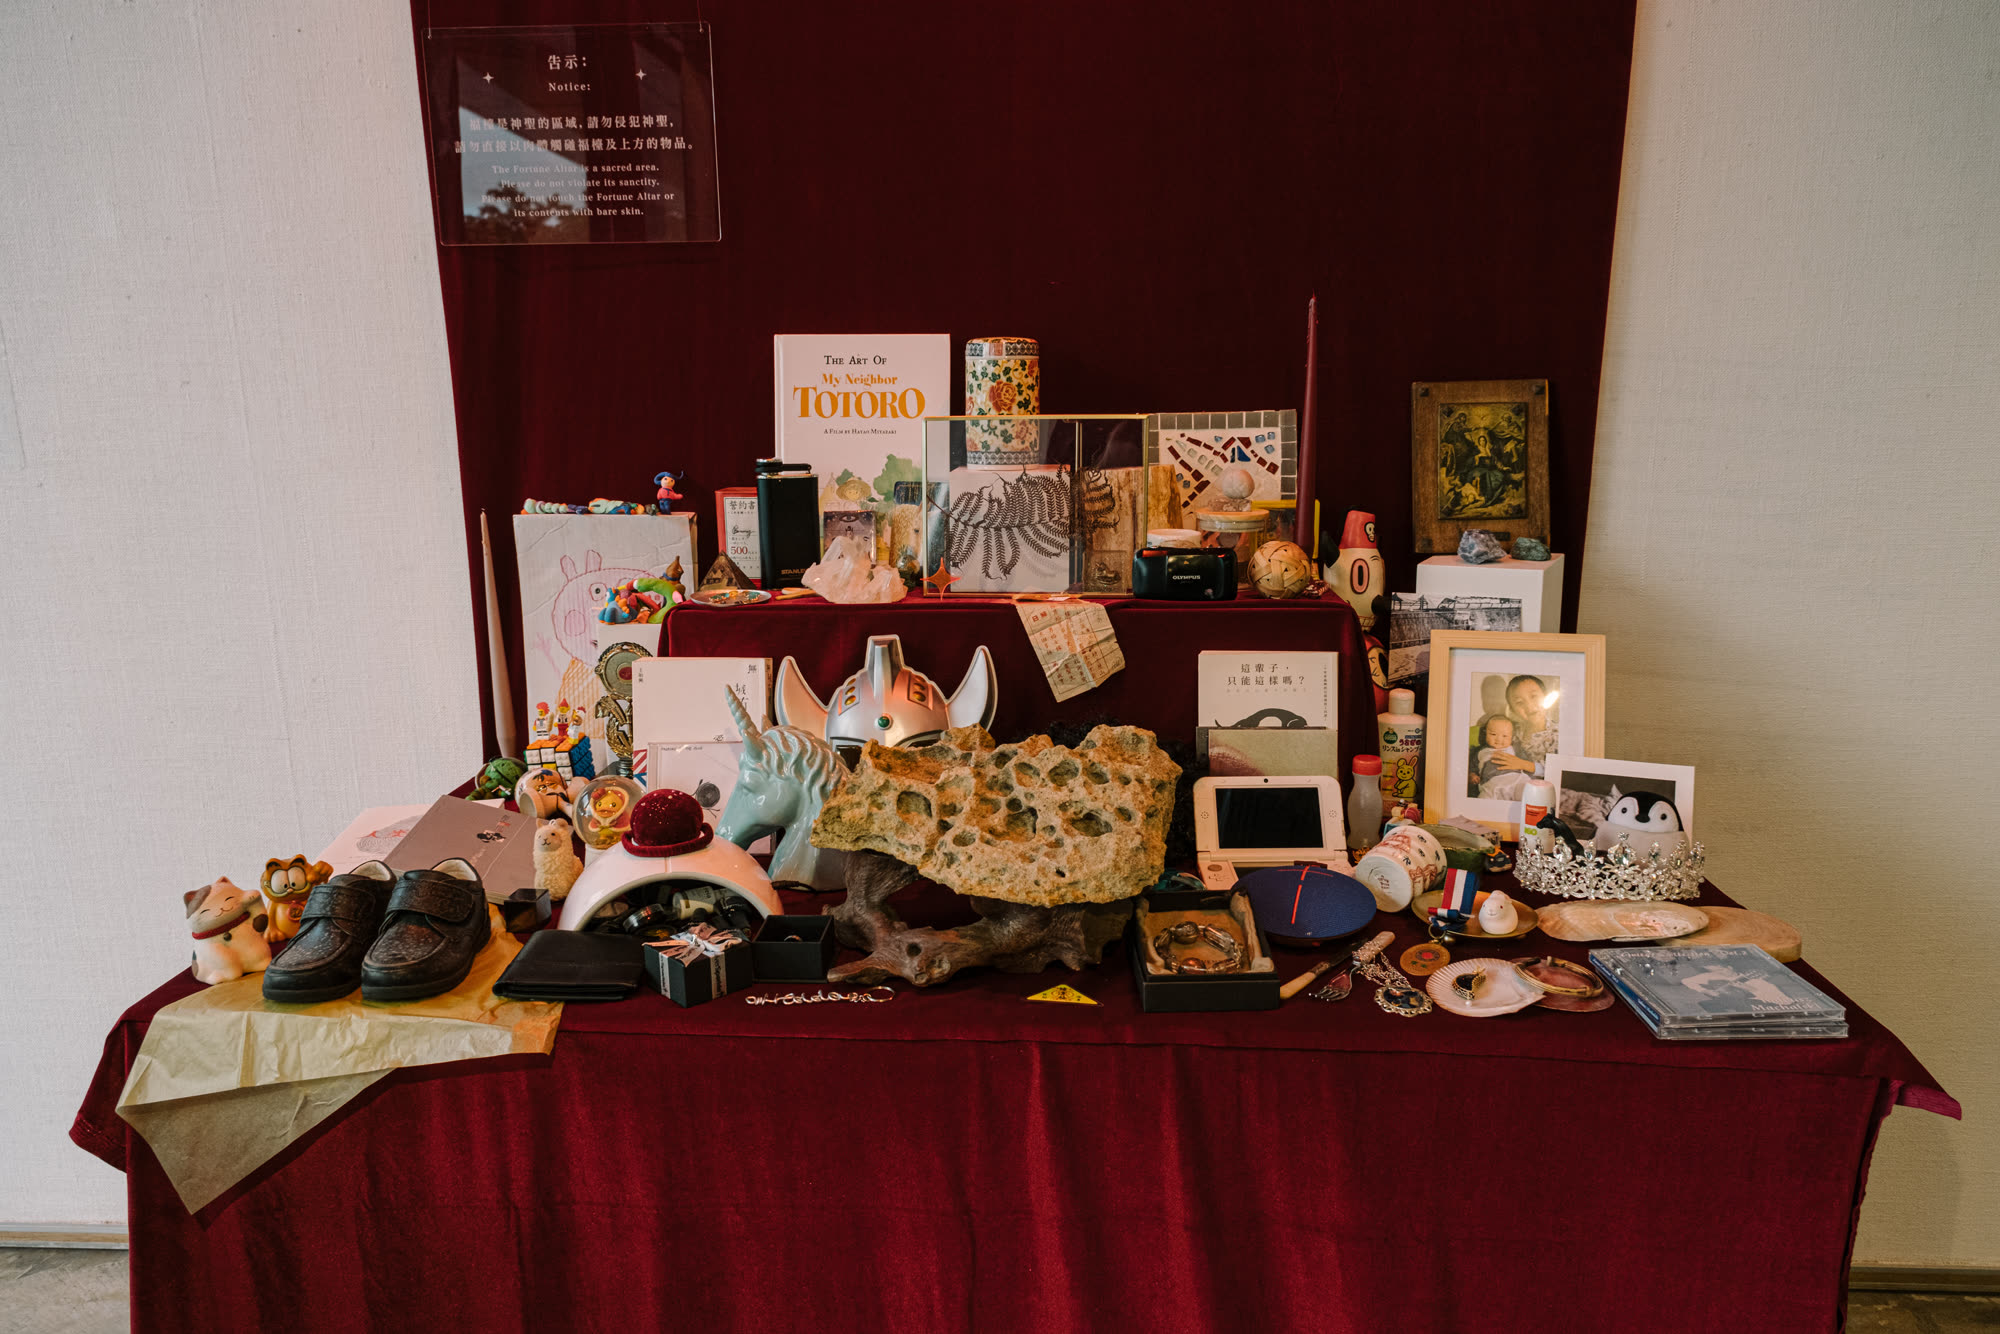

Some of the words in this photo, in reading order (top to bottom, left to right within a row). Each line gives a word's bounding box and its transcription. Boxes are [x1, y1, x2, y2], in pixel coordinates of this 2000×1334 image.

[548, 82, 591, 92] Notice:
[492, 165, 510, 174] The
[513, 165, 549, 174] Fortune
[553, 164, 578, 174] Altar
[581, 164, 589, 173] is
[601, 163, 633, 172] sacred
[635, 164, 660, 172] area.
[501, 179, 531, 188] Please
[534, 179, 546, 188] do
[550, 179, 565, 188] not
[567, 178, 600, 187] violate
[603, 178, 616, 187] its
[619, 177, 660, 188] sanctity.
[481, 194, 512, 203] Please
[514, 194, 527, 203] do
[529, 194, 545, 203] not
[548, 193, 575, 202] touch
[578, 193, 593, 202] the
[596, 192, 633, 201] Fortune
[637, 192, 661, 200] Altar
[514, 208, 526, 217] its
[529, 208, 570, 217] contents
[573, 207, 594, 216] with
[596, 207, 618, 216] bare
[620, 207, 644, 216] skin.
[821, 373, 841, 388] My
[845, 373, 898, 388] Neighbor
[792, 384, 926, 419] TOTORO
[730, 546, 748, 555] 500
